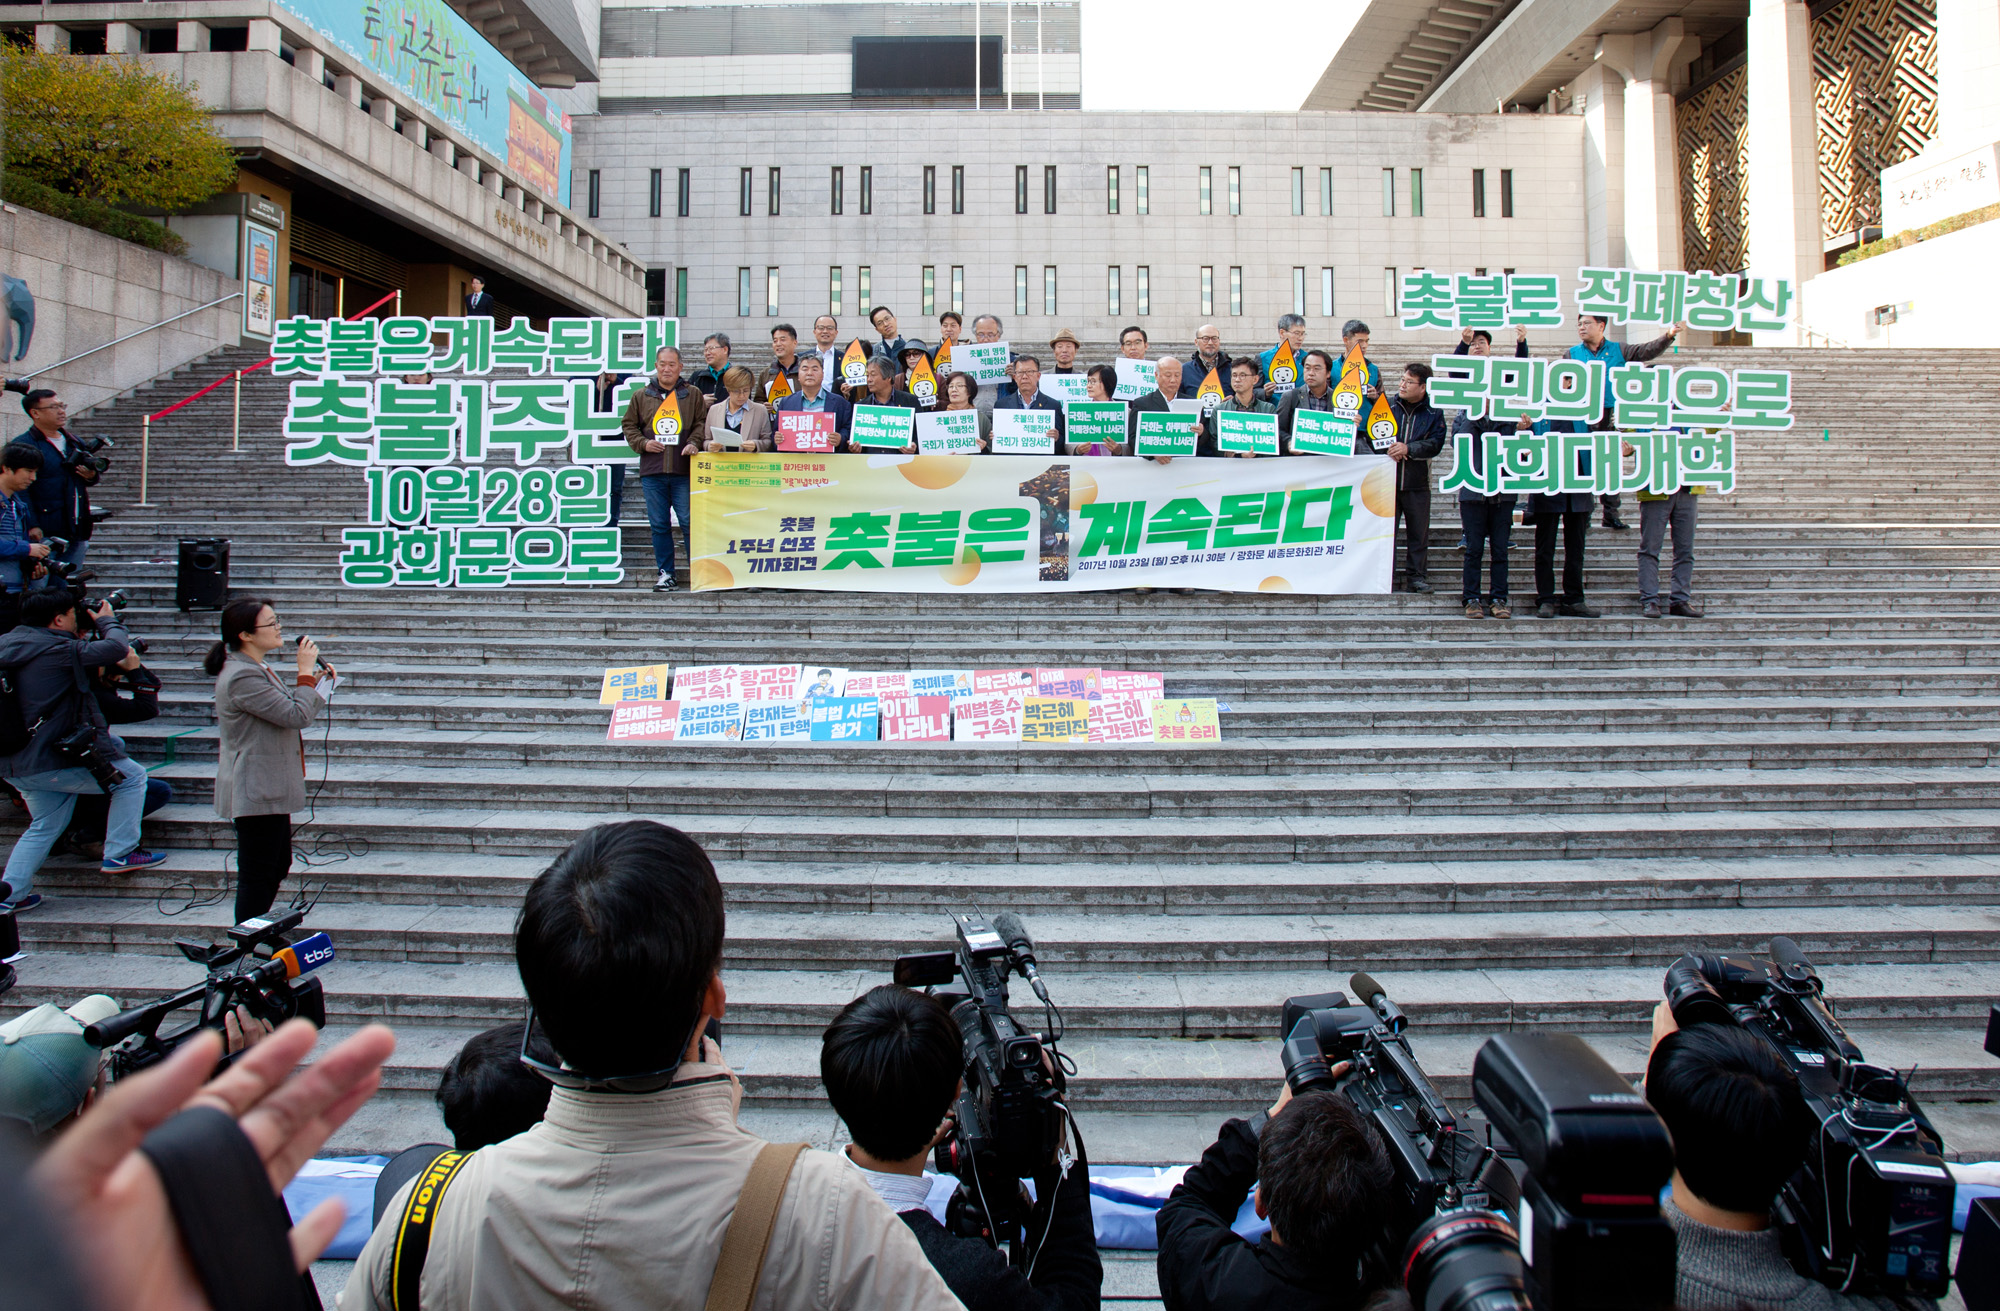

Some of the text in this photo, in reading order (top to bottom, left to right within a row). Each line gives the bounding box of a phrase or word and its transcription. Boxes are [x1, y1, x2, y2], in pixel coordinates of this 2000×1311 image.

[1401, 268, 1792, 332] 촛불로 적폐청산
[970, 348, 989, 358] 촛불의
[1116, 384, 1138, 395] 국회가
[1429, 356, 1794, 429] 국민의 힘으로
[288, 379, 647, 465] 촛불1주년
[781, 414, 814, 432] 적폐
[855, 413, 878, 425] 국회는
[936, 414, 974, 426] 촛불의 명령
[1013, 414, 1051, 424] 촛불의 명령
[1068, 411, 1091, 422] 국회는
[1221, 419, 1243, 431] 국회는
[1297, 418, 1320, 430] 국회는
[888, 428, 909, 439] 나서라
[1103, 424, 1124, 434] 나서라
[1141, 421, 1163, 432] 국회는
[795, 431, 828, 449] 청산
[922, 439, 944, 450] 국회가
[996, 437, 1019, 448] 국회가
[1173, 436, 1194, 447] 나서라
[1254, 434, 1275, 445] 나서라
[1330, 435, 1352, 448] 나서라
[697, 461, 712, 470] 주최
[783, 463, 811, 472] 참가단위
[811, 463, 826, 472] 일동
[1442, 430, 1735, 496] 사회대개혁
[697, 476, 712, 485] 주관
[779, 516, 816, 533] 촛불
[820, 507, 1031, 571] 촛불은
[1077, 485, 1354, 557] 계속된다
[779, 536, 816, 553] 선포
[342, 527, 623, 587] 광화문으로
[747, 556, 818, 574] 기자회견
[1078, 559, 1106, 570] 2017년
[1109, 558, 1128, 569] 10월
[1129, 557, 1151, 568] 23일
[1169, 554, 1189, 565] 오후
[1190, 553, 1204, 563] 1시
[1206, 552, 1226, 562] 30분
[1237, 549, 1265, 561] 광화문
[1267, 546, 1324, 559] 세종문화회관
[1325, 544, 1345, 555] 계단
[609, 671, 638, 687] 2월
[676, 666, 738, 688] 재벌총수
[740, 666, 798, 687] 황교안
[846, 674, 906, 691] 2월 탄핵
[912, 674, 956, 690] 적폐를
[975, 671, 1024, 690] 박근혜
[1040, 670, 1065, 683] 이제
[1102, 674, 1149, 691] 박근혜
[622, 684, 658, 701] 탄핵
[615, 704, 663, 723] 헌재는
[680, 702, 740, 722] 황교안은
[748, 705, 797, 724] 헌재는
[812, 701, 878, 723] 불법 사드
[883, 696, 919, 718] 이게
[955, 696, 1021, 721] 재벌총수
[1024, 701, 1075, 720] 박근혜
[1088, 699, 1144, 724] 박근혜
[613, 717, 677, 739] 탄핵하라
[679, 717, 741, 737] 사퇴하라
[744, 719, 811, 741] 조기 탄핵
[830, 721, 862, 739] 철거
[972, 716, 1017, 739] 구속!
[1158, 724, 1217, 739] 촛불 승리
[303, 946, 333, 964] tbs
[411, 1153, 463, 1225] Nikon
